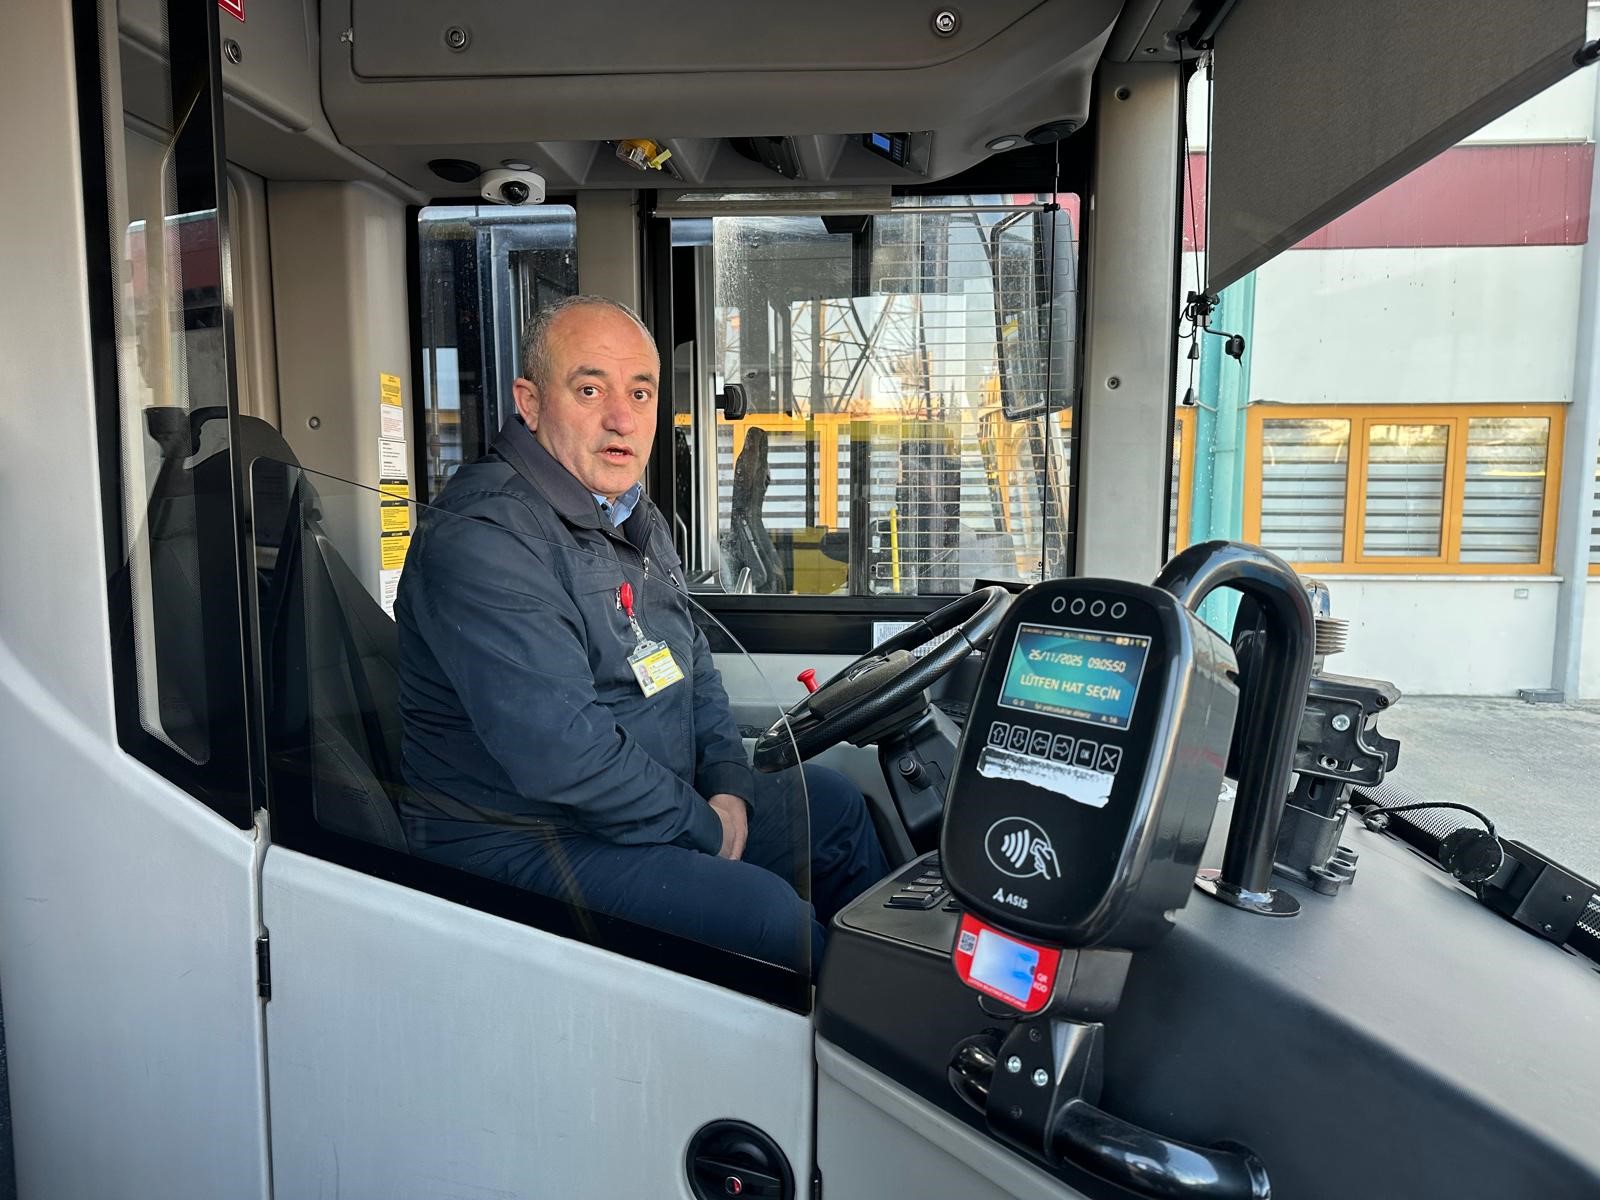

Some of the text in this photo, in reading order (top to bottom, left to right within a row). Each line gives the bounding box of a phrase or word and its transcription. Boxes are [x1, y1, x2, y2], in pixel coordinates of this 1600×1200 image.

[1028, 649, 1083, 666] 25/11/2025
[1020, 673, 1121, 700] LÜTFEN HAT SEÇİN
[1005, 893, 1028, 910] ASIS
